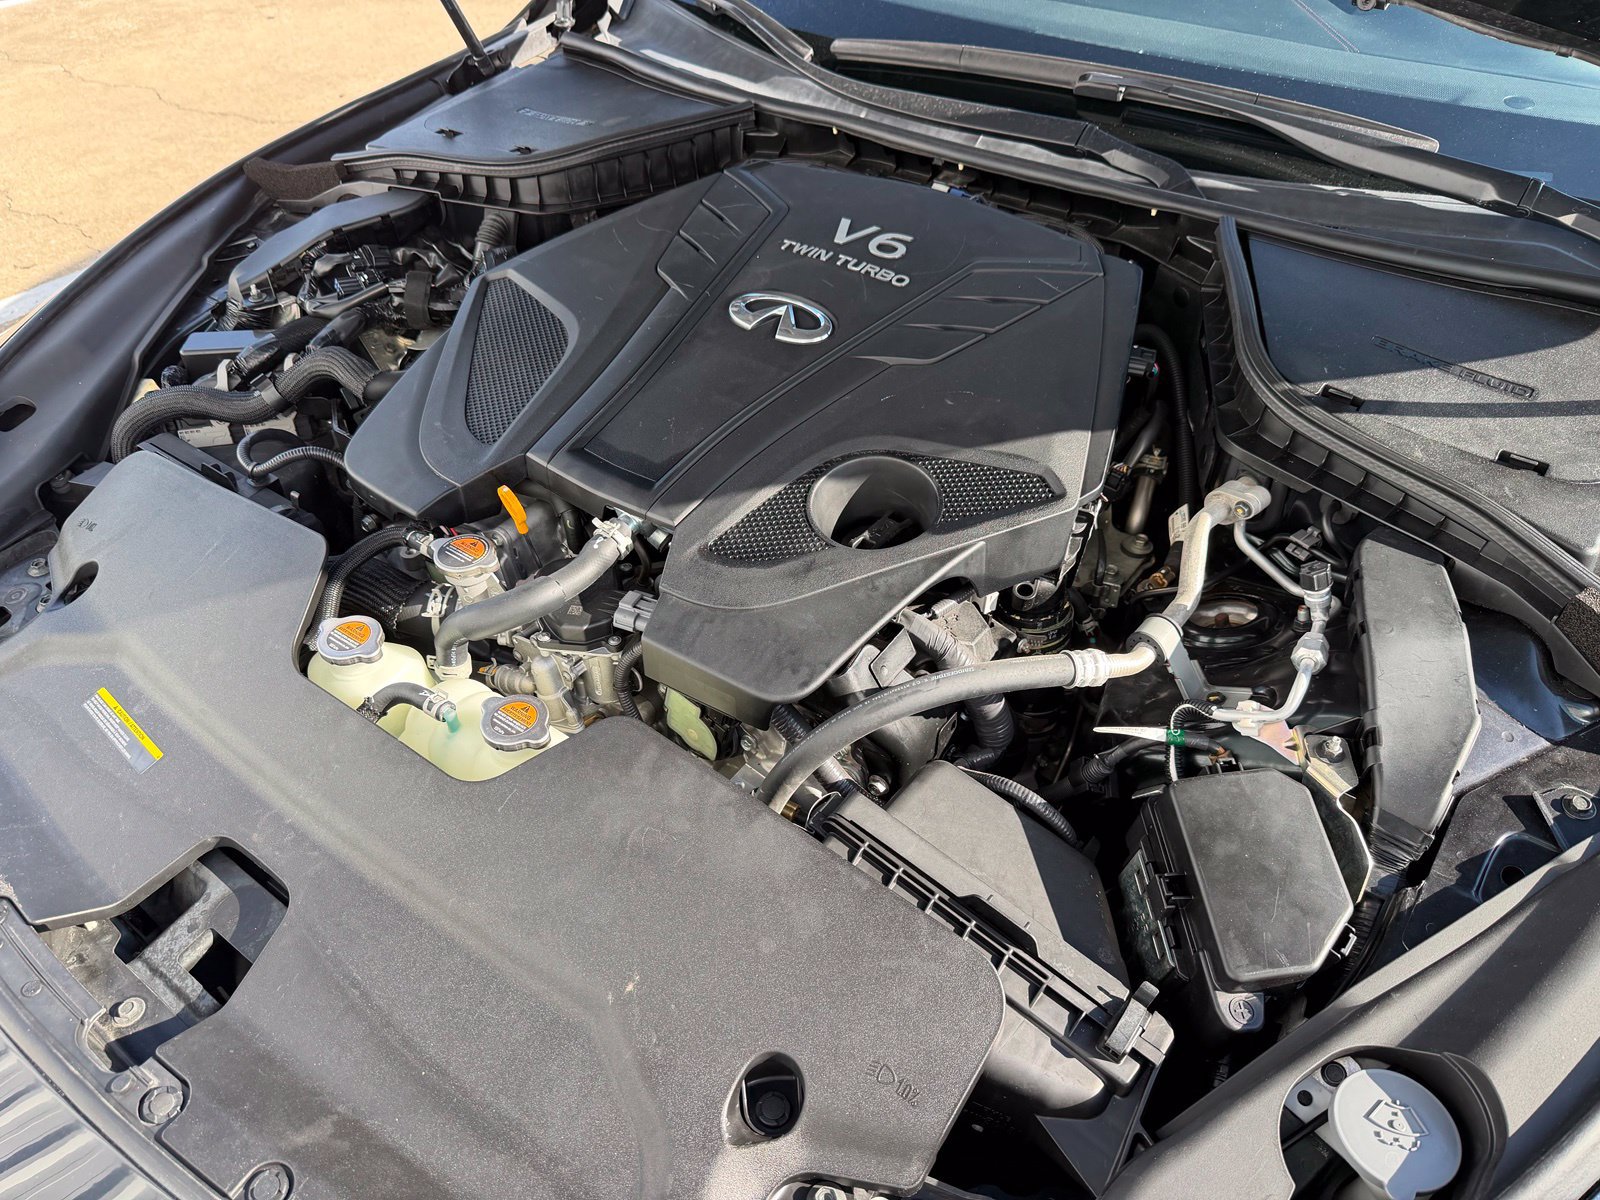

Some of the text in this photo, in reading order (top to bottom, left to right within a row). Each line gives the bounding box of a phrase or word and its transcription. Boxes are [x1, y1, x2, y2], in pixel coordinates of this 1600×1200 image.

[834, 217, 914, 259] V6
[780, 239, 910, 287] TWIN TURBO
[1458, 368, 1532, 398] FLUID
